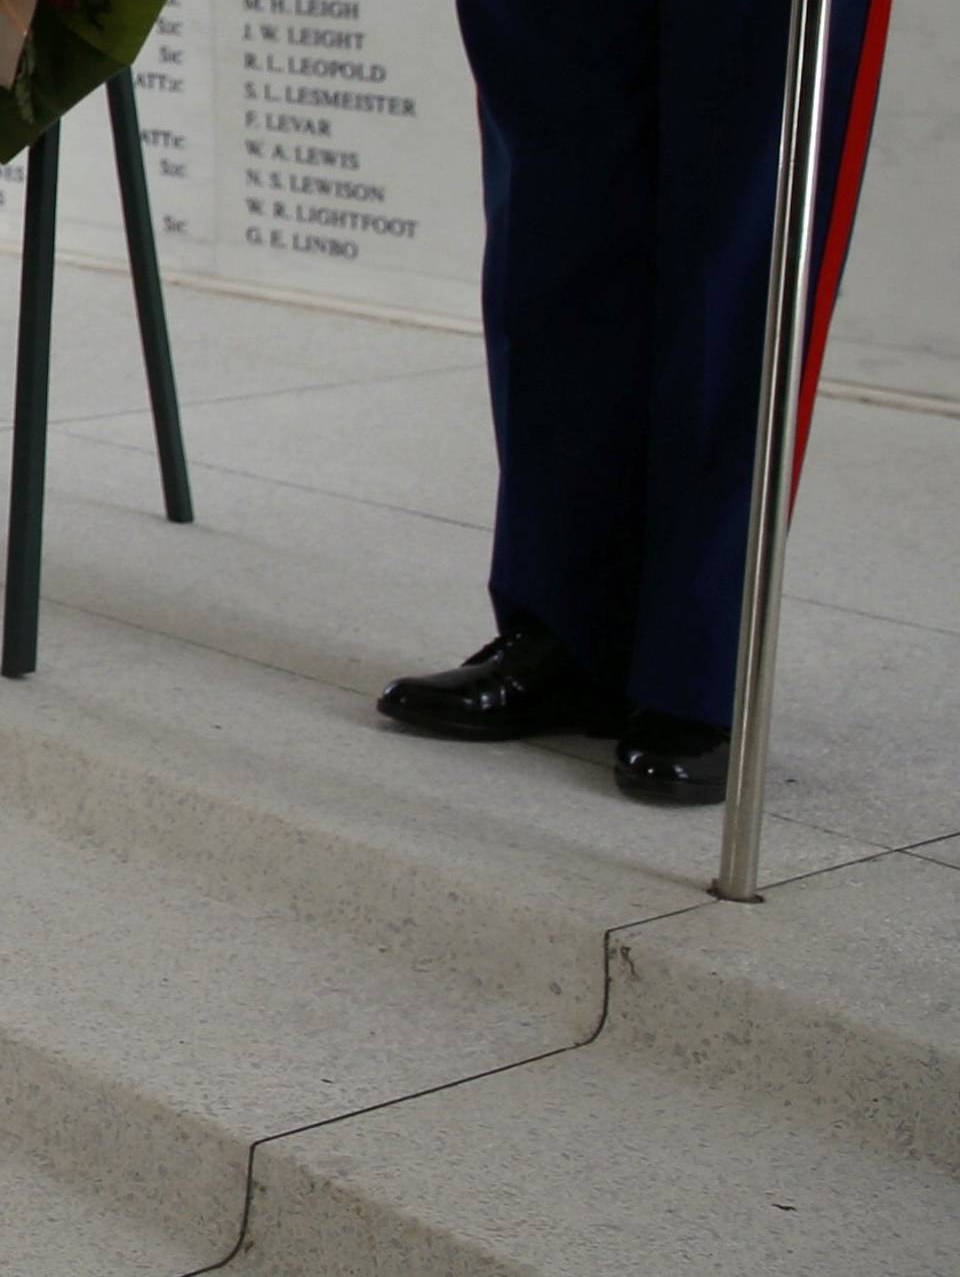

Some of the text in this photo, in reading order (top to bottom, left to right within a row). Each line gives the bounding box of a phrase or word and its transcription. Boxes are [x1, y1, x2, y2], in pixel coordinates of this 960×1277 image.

[288, 57, 386, 83] LEOPOLD
[286, 86, 416, 116] LESMEISTER
[266, 113, 331, 137] LEVAR
[295, 146, 360, 170] LEWIS
[296, 205, 417, 238] LIGHTFOOT
